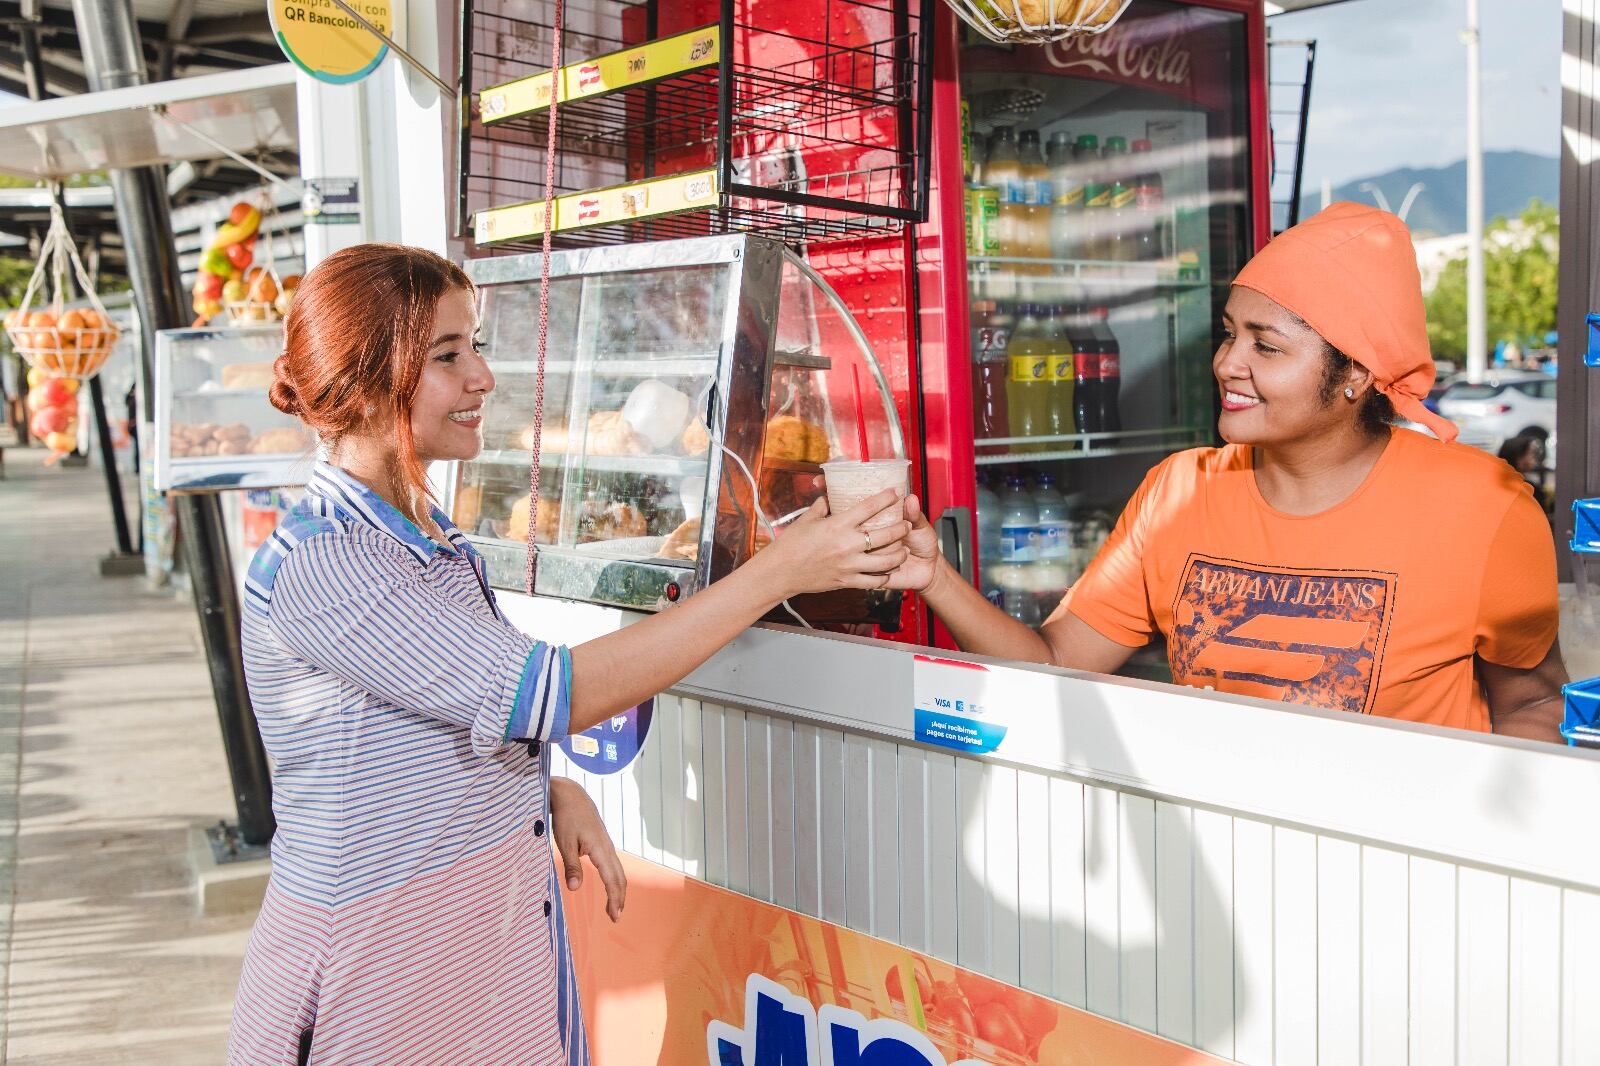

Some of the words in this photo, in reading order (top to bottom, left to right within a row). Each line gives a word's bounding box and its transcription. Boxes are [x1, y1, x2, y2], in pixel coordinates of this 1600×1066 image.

[365, 6, 387, 16] con
[285, 6, 305, 21] QR
[309, 11, 385, 32] Bancolomia
[1190, 567, 1292, 603] ARMANI
[1290, 580, 1377, 609] JEANS
[934, 697, 951, 708] VISA
[926, 729, 945, 738] pagos
[948, 725, 978, 736] recibimos
